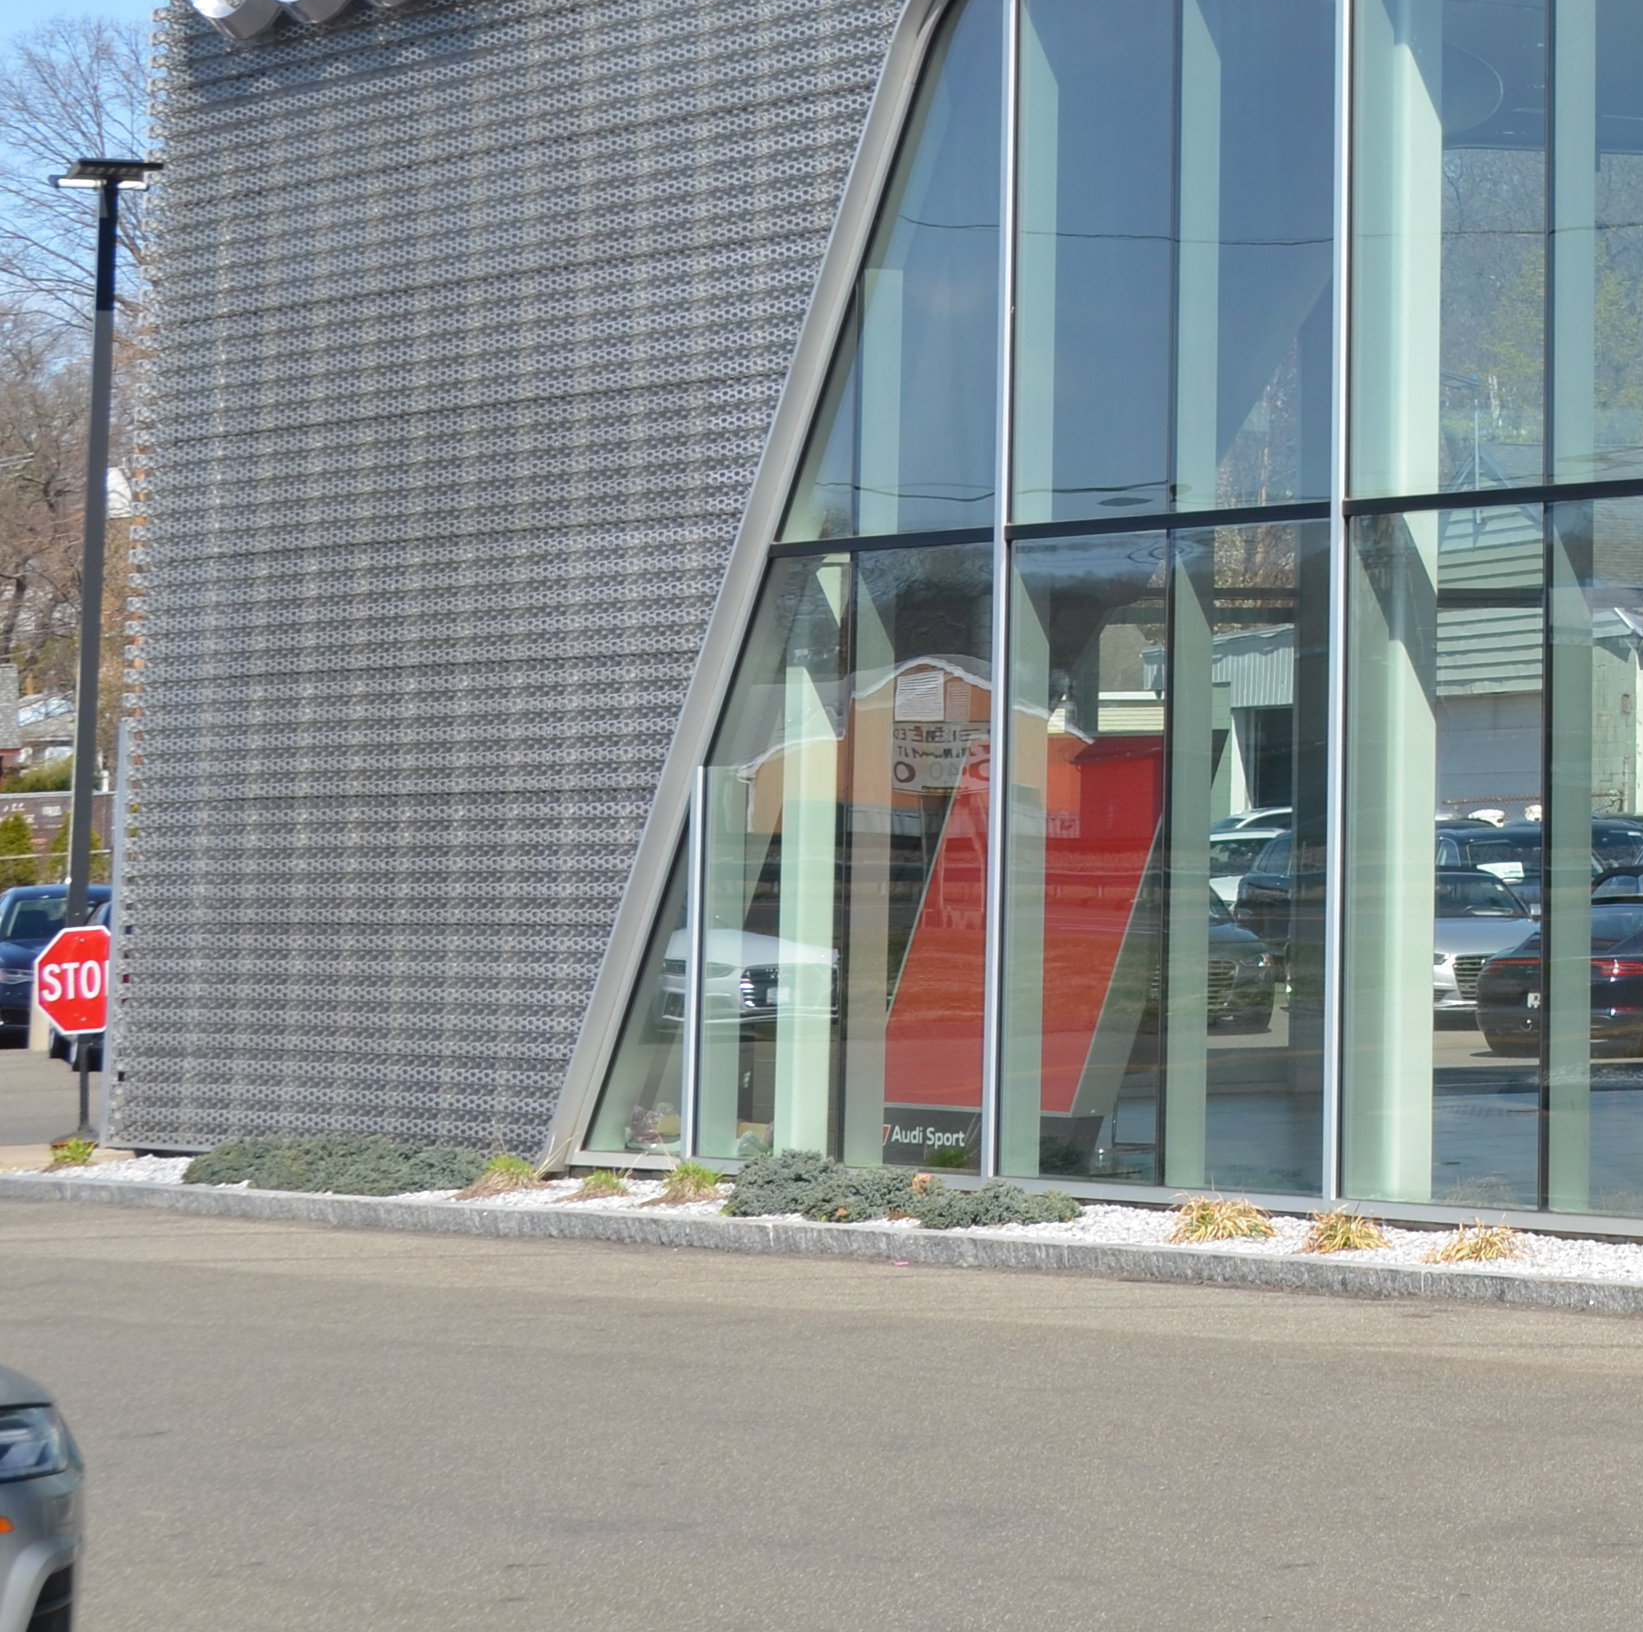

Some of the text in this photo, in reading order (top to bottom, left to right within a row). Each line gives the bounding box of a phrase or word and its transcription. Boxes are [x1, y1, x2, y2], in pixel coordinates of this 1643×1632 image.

[42, 960, 110, 1002] STO
[891, 1124, 966, 1150] Audi Sport
